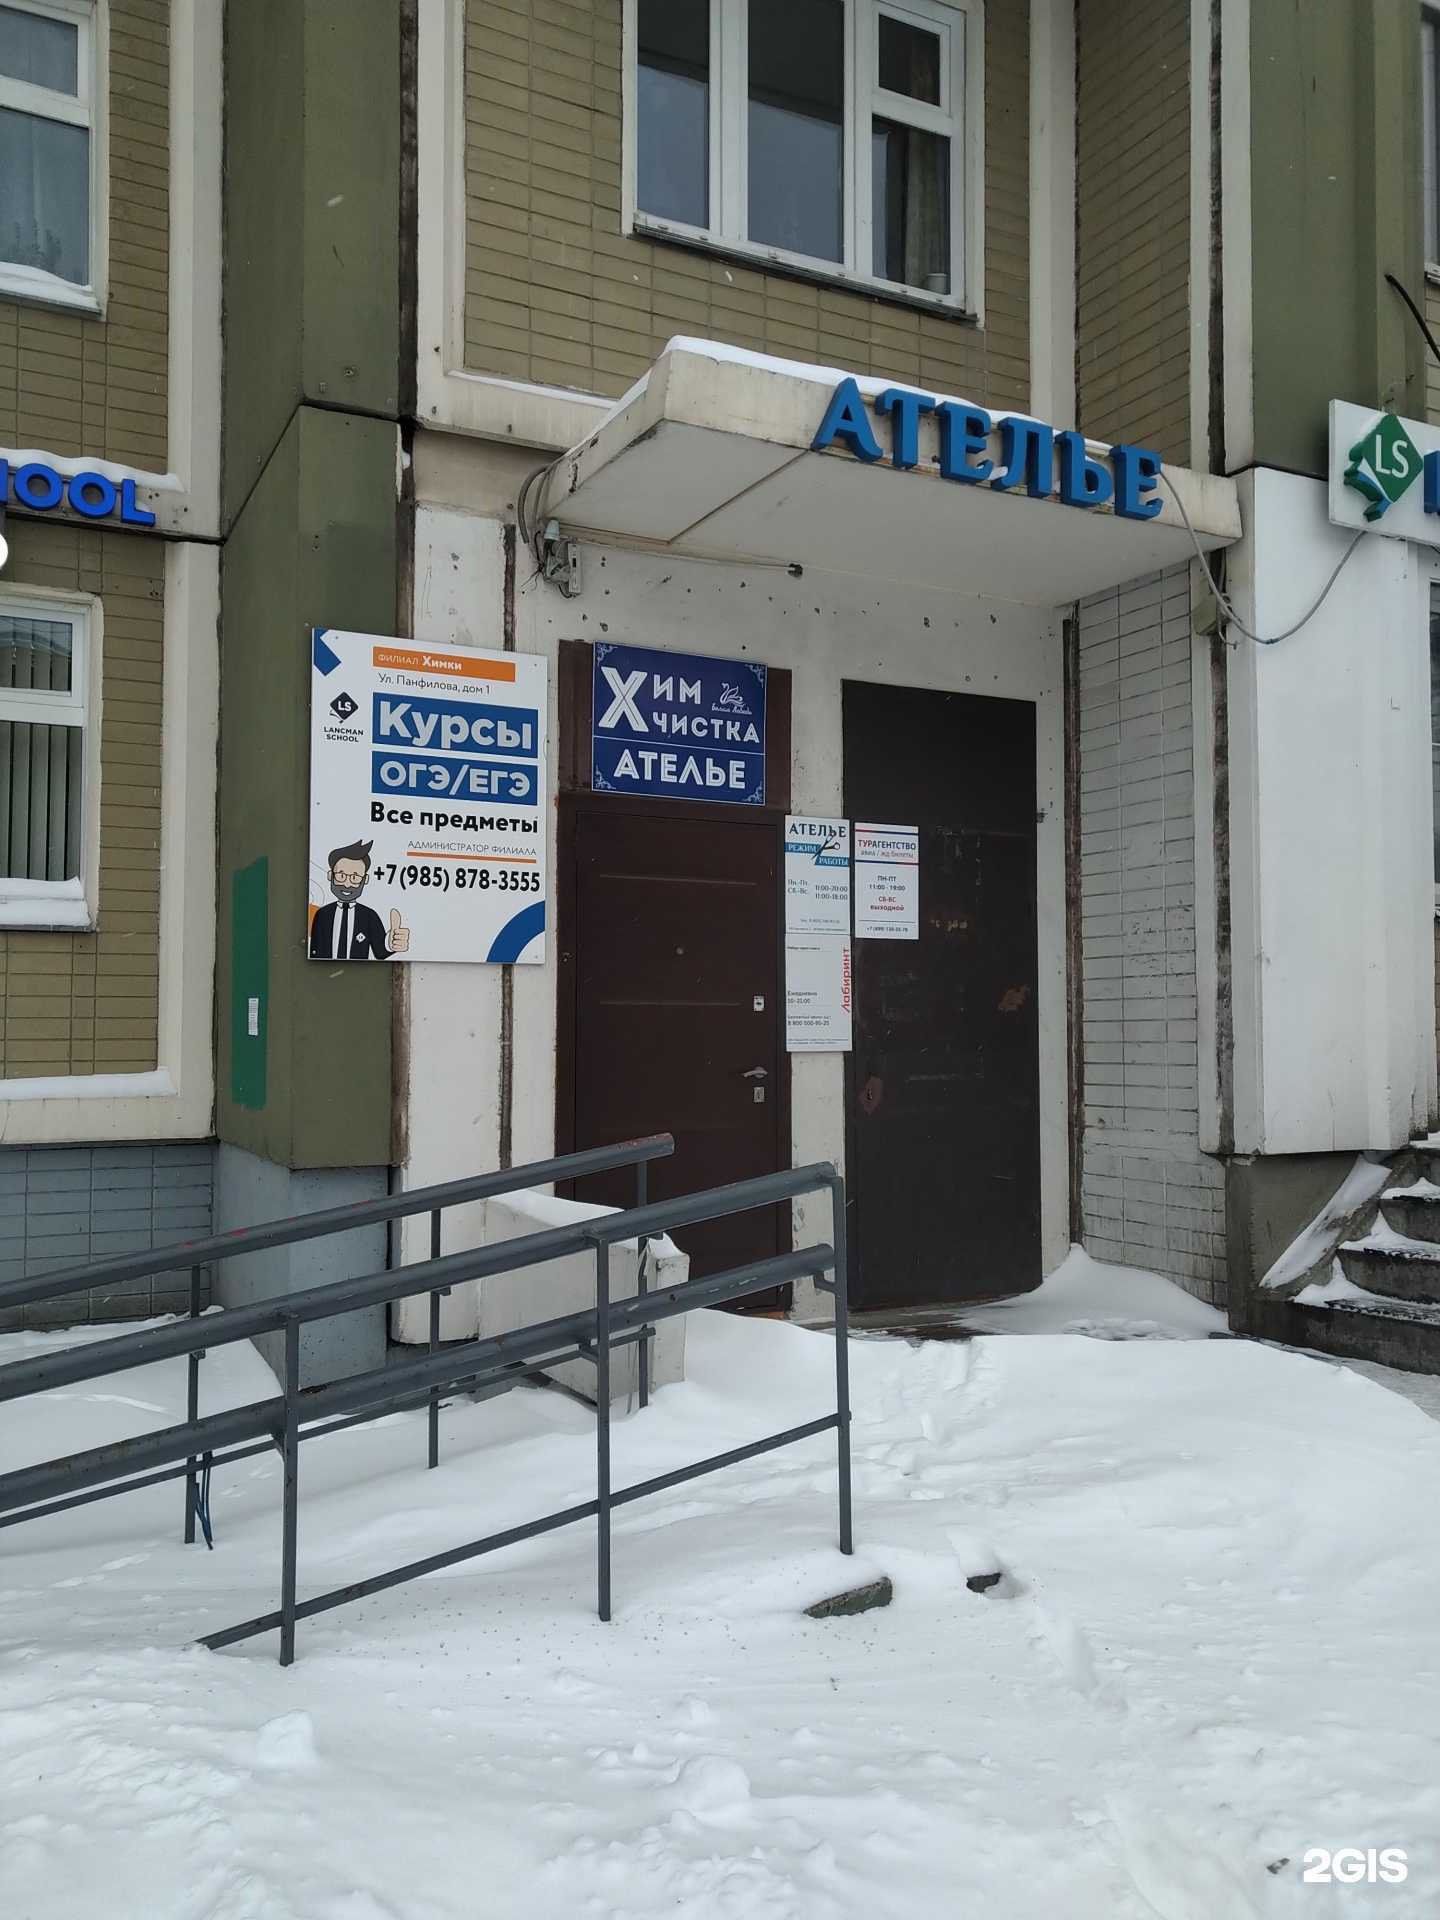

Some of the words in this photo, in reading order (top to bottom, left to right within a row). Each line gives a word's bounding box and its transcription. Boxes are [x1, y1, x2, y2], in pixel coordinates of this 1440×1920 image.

[810, 377, 1164, 520] АТЕЛЬЕ
[1376, 434, 1409, 478] LS
[377, 654, 418, 665] ФИЛИАЛ
[423, 656, 462, 671] Химки
[378, 673, 394, 685] Ул.
[397, 675, 460, 693] Панфилова,
[486, 685, 490, 694] 1
[338, 701, 352, 711] LS
[323, 727, 364, 735] LANCMAN
[380, 701, 532, 750] Курсы
[653, 712, 760, 743] ЧИСТКА
[326, 734, 359, 742] SCHOOL
[380, 761, 531, 797] ОГЭ/ЕГЭ
[613, 749, 746, 789] АТЕЛЬЕ
[371, 802, 413, 824] Все
[420, 812, 538, 833] предметы
[789, 823, 846, 838] АТЕЛЬЕ
[408, 840, 489, 853] АДМИНИСТРАТОР
[491, 846, 537, 856] ФИЛИАЛА
[858, 840, 917, 850] ТУРАГЕНТСТВО
[819, 857, 849, 866] РАБОТЫ
[455, 868, 540, 892] 878-3555
[841, 948, 851, 1014] Лабиринт
